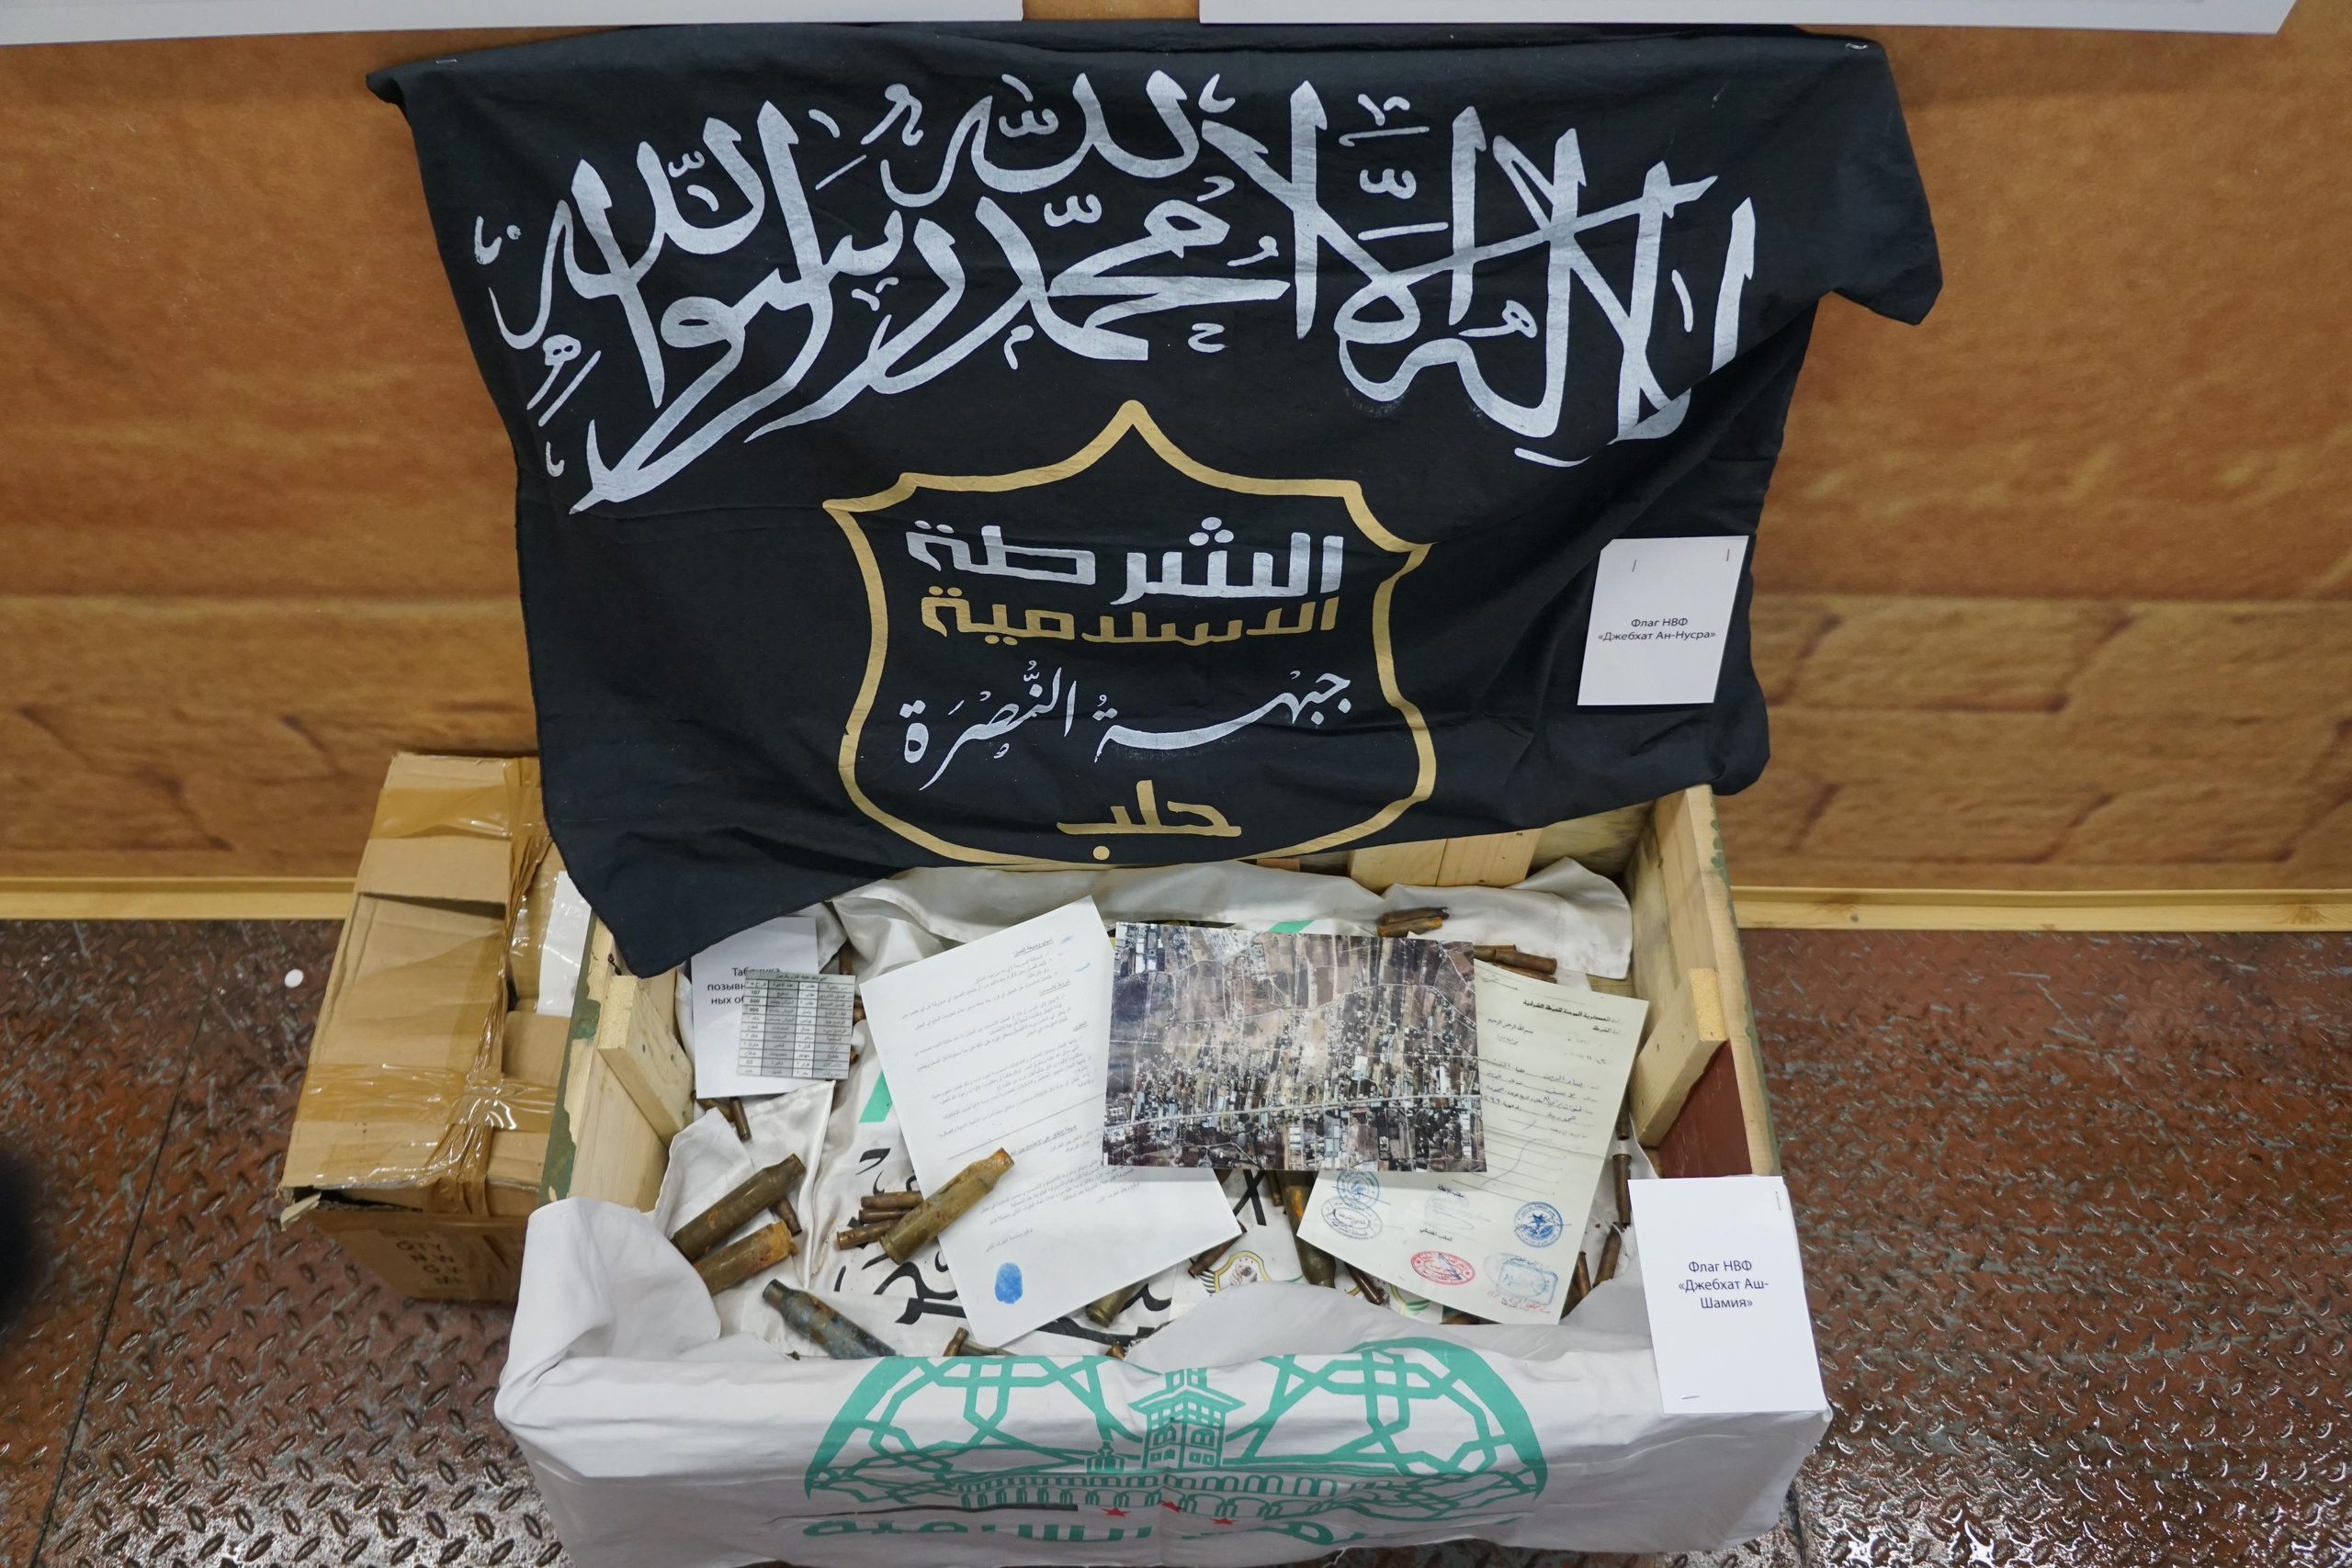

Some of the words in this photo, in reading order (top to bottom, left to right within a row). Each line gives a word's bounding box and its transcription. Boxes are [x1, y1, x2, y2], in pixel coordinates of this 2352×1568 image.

[906, 517, 1343, 604] الشرطة
[1631, 618, 1659, 627] Флаг
[1662, 617, 1689, 626] НВФ
[1598, 631, 1653, 642] «Джебхат
[1655, 630, 1716, 641] Ан-Нусра»
[1057, 780, 1242, 861] حلب
[1689, 1261, 1720, 1272] Флаг
[1723, 1259, 1752, 1271] НВФ
[1679, 1278, 1740, 1292] «Джебхат
[1745, 1278, 1770, 1290] Аш-
[1700, 1297, 1753, 1309] Шамия»
